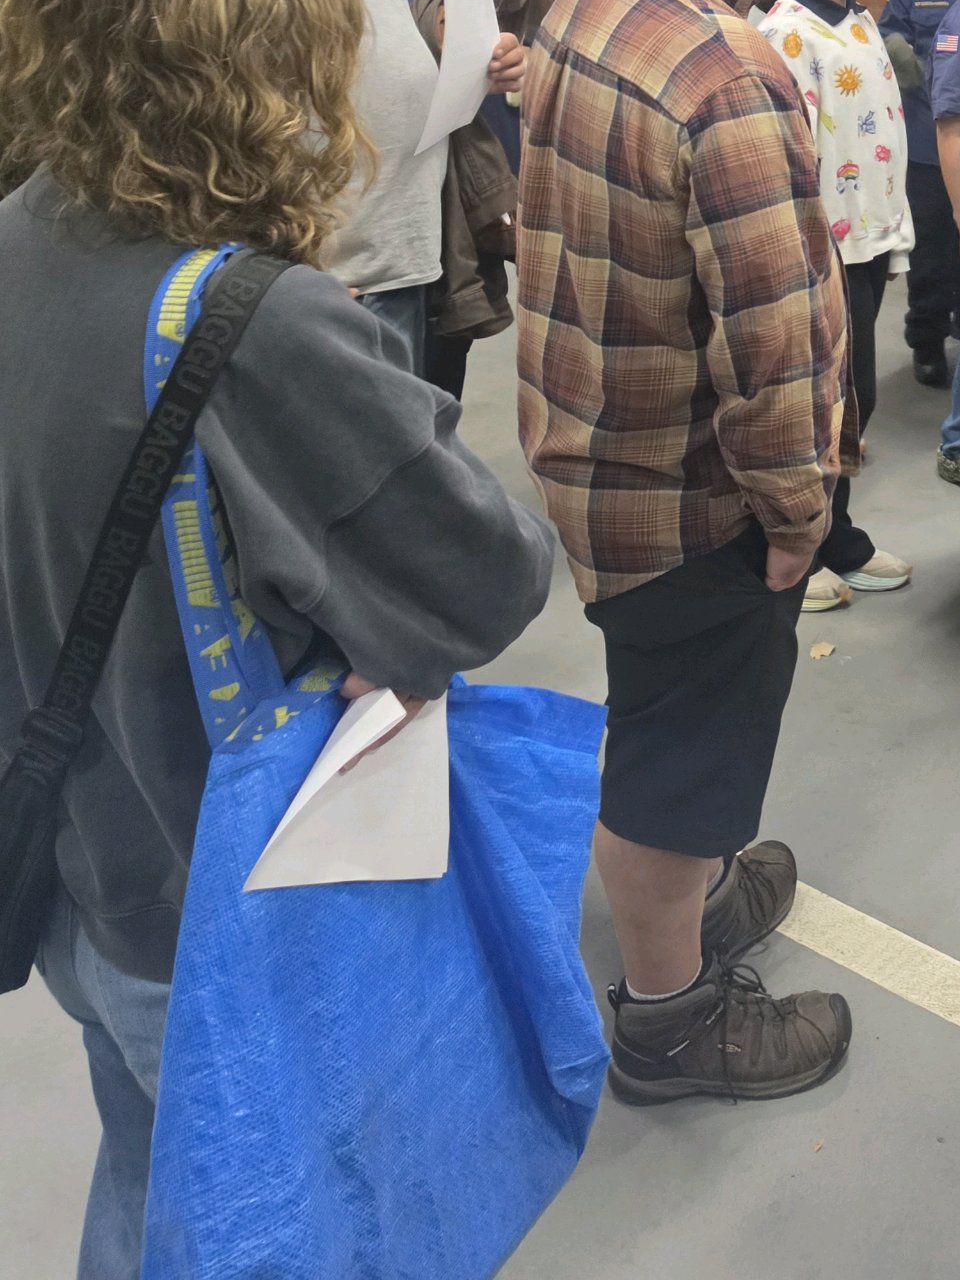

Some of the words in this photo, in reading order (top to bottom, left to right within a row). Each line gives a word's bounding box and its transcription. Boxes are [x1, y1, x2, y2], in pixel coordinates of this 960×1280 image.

[176, 276, 260, 394] BAGGU
[119, 400, 193, 518] BAGGU
[82, 526, 141, 631] BAGGU
